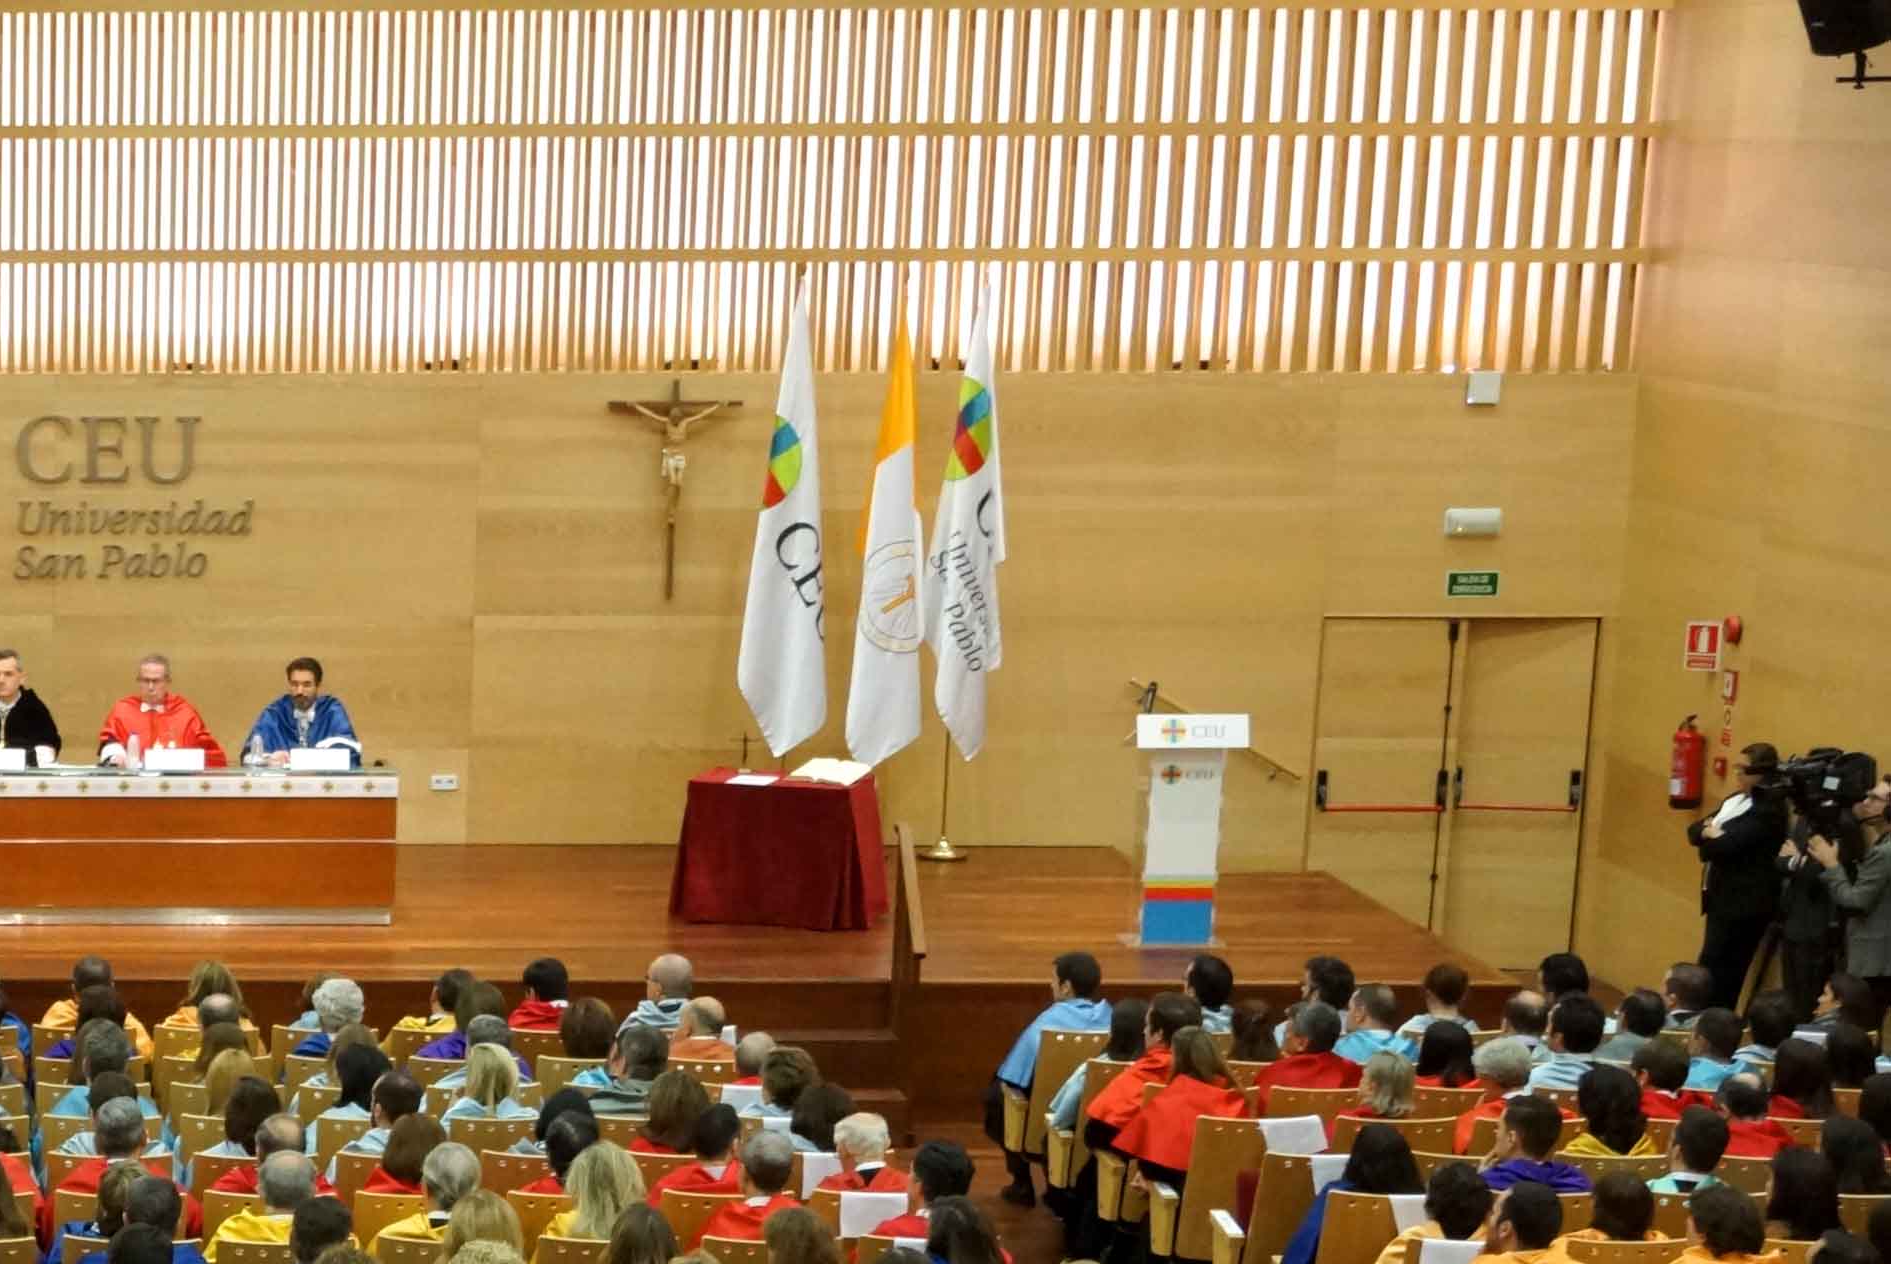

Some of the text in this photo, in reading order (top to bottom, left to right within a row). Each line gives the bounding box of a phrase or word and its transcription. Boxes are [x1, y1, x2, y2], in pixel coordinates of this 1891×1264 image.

[14, 415, 202, 486] CEU
[17, 500, 255, 537] Universidad
[12, 543, 208, 581] San Pablo
[1191, 725, 1227, 738] CEU
